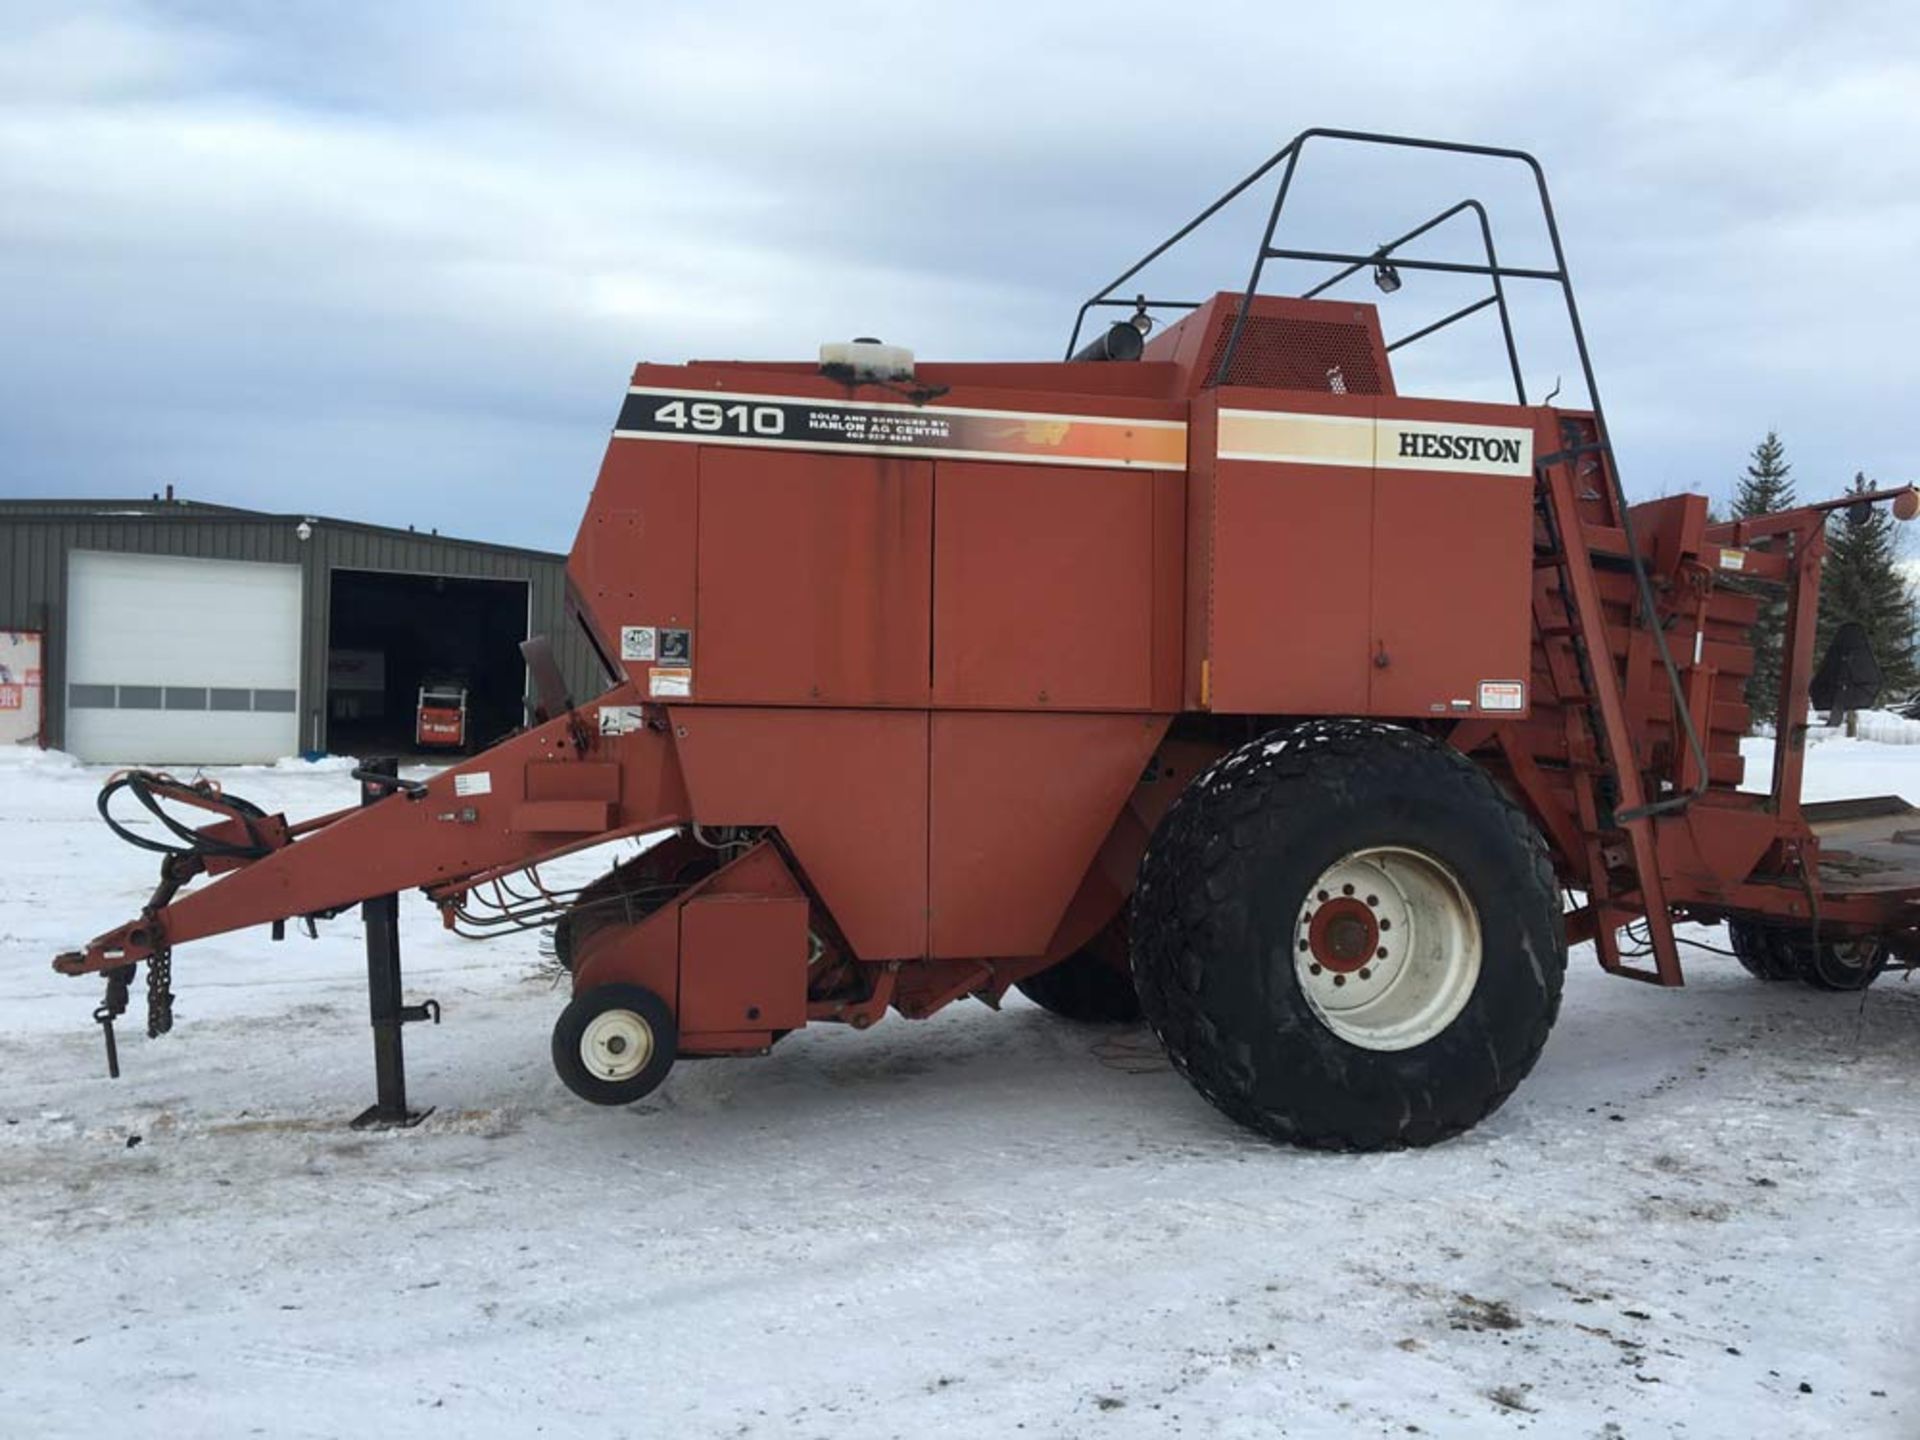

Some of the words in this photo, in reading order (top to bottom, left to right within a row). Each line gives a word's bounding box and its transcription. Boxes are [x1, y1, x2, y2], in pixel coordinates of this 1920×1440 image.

[654, 400, 785, 435] 4910
[809, 412, 840, 421] SOLD
[844, 414, 867, 423] AND
[809, 420, 865, 432] HANLON
[871, 424, 890, 433] AG
[896, 425, 949, 437] CENTRE
[1399, 432, 1521, 463] HESSTON
